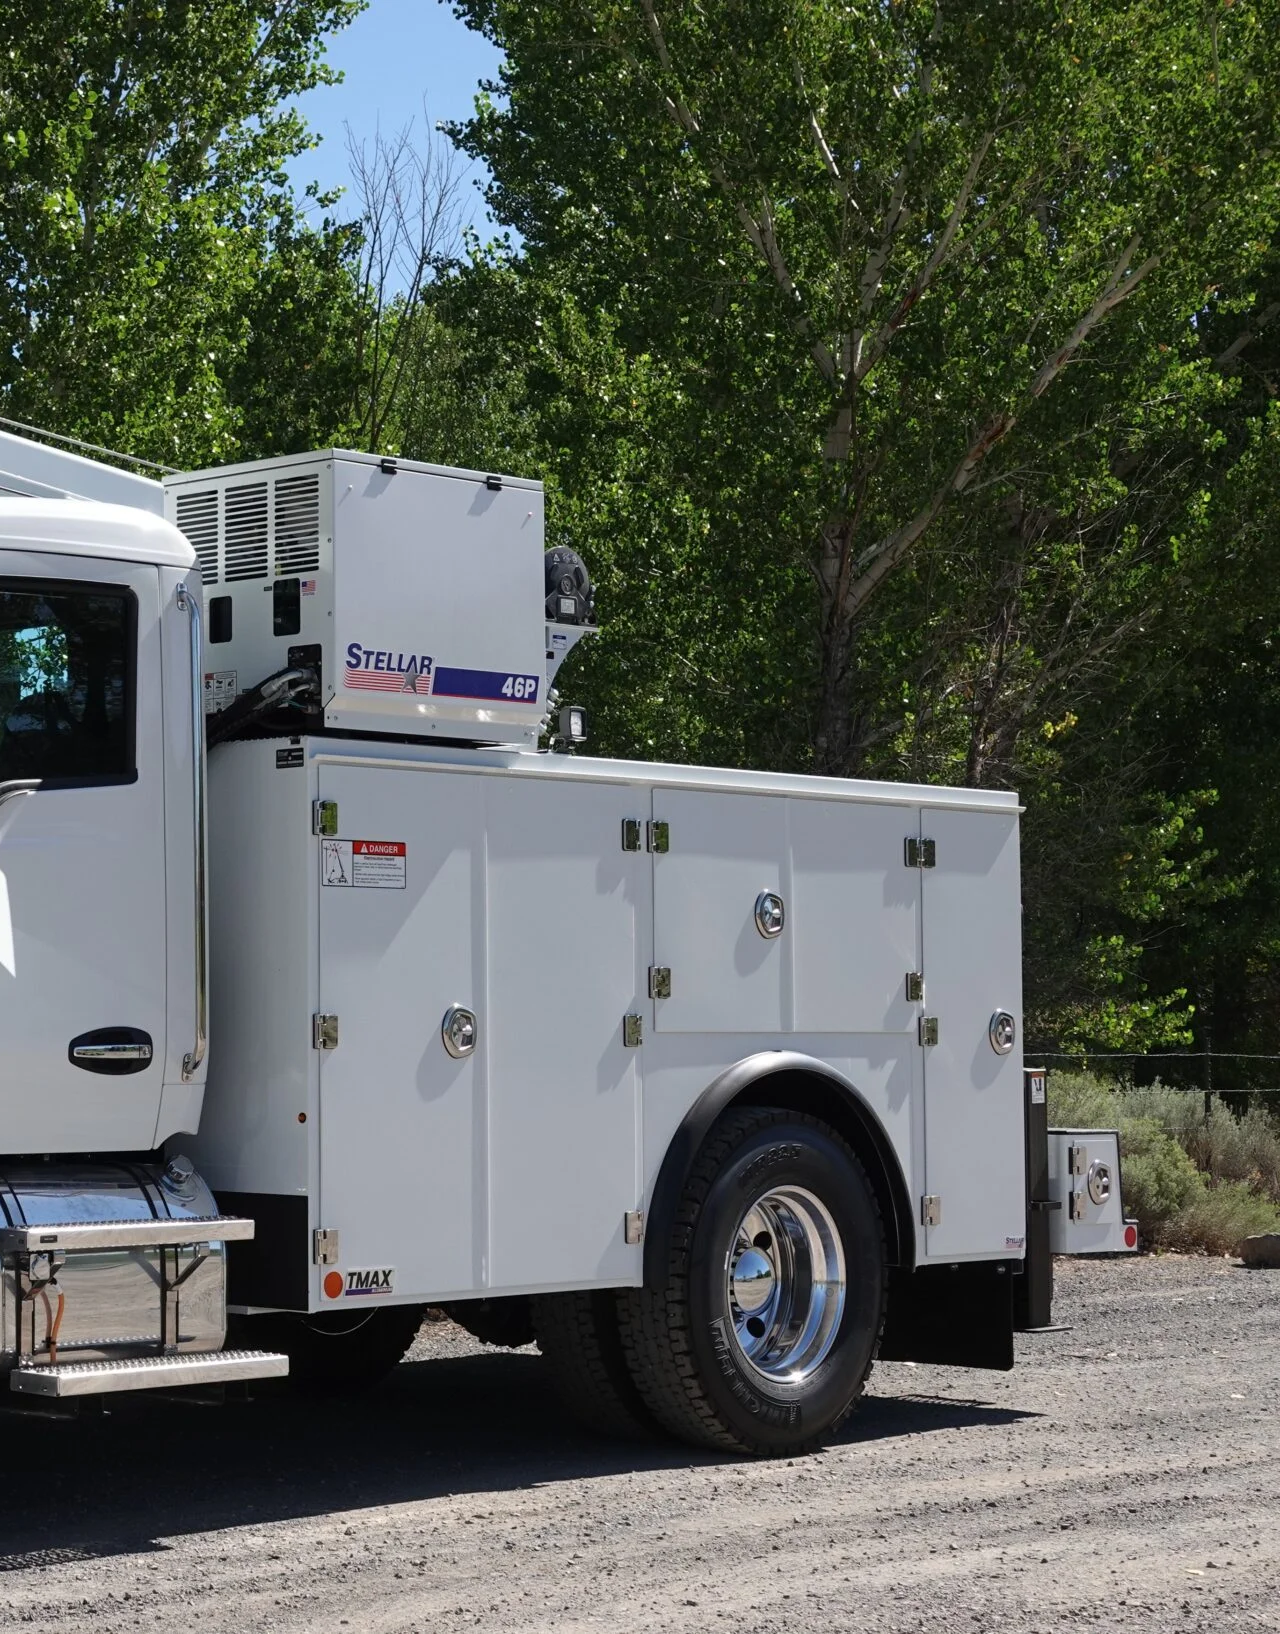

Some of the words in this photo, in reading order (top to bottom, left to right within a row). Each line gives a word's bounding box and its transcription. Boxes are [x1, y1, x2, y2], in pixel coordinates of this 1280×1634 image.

[346, 642, 433, 675] STELLAR
[501, 676, 537, 699] 46P
[369, 845, 398, 853] DANGER
[347, 1269, 393, 1289] TMAX
